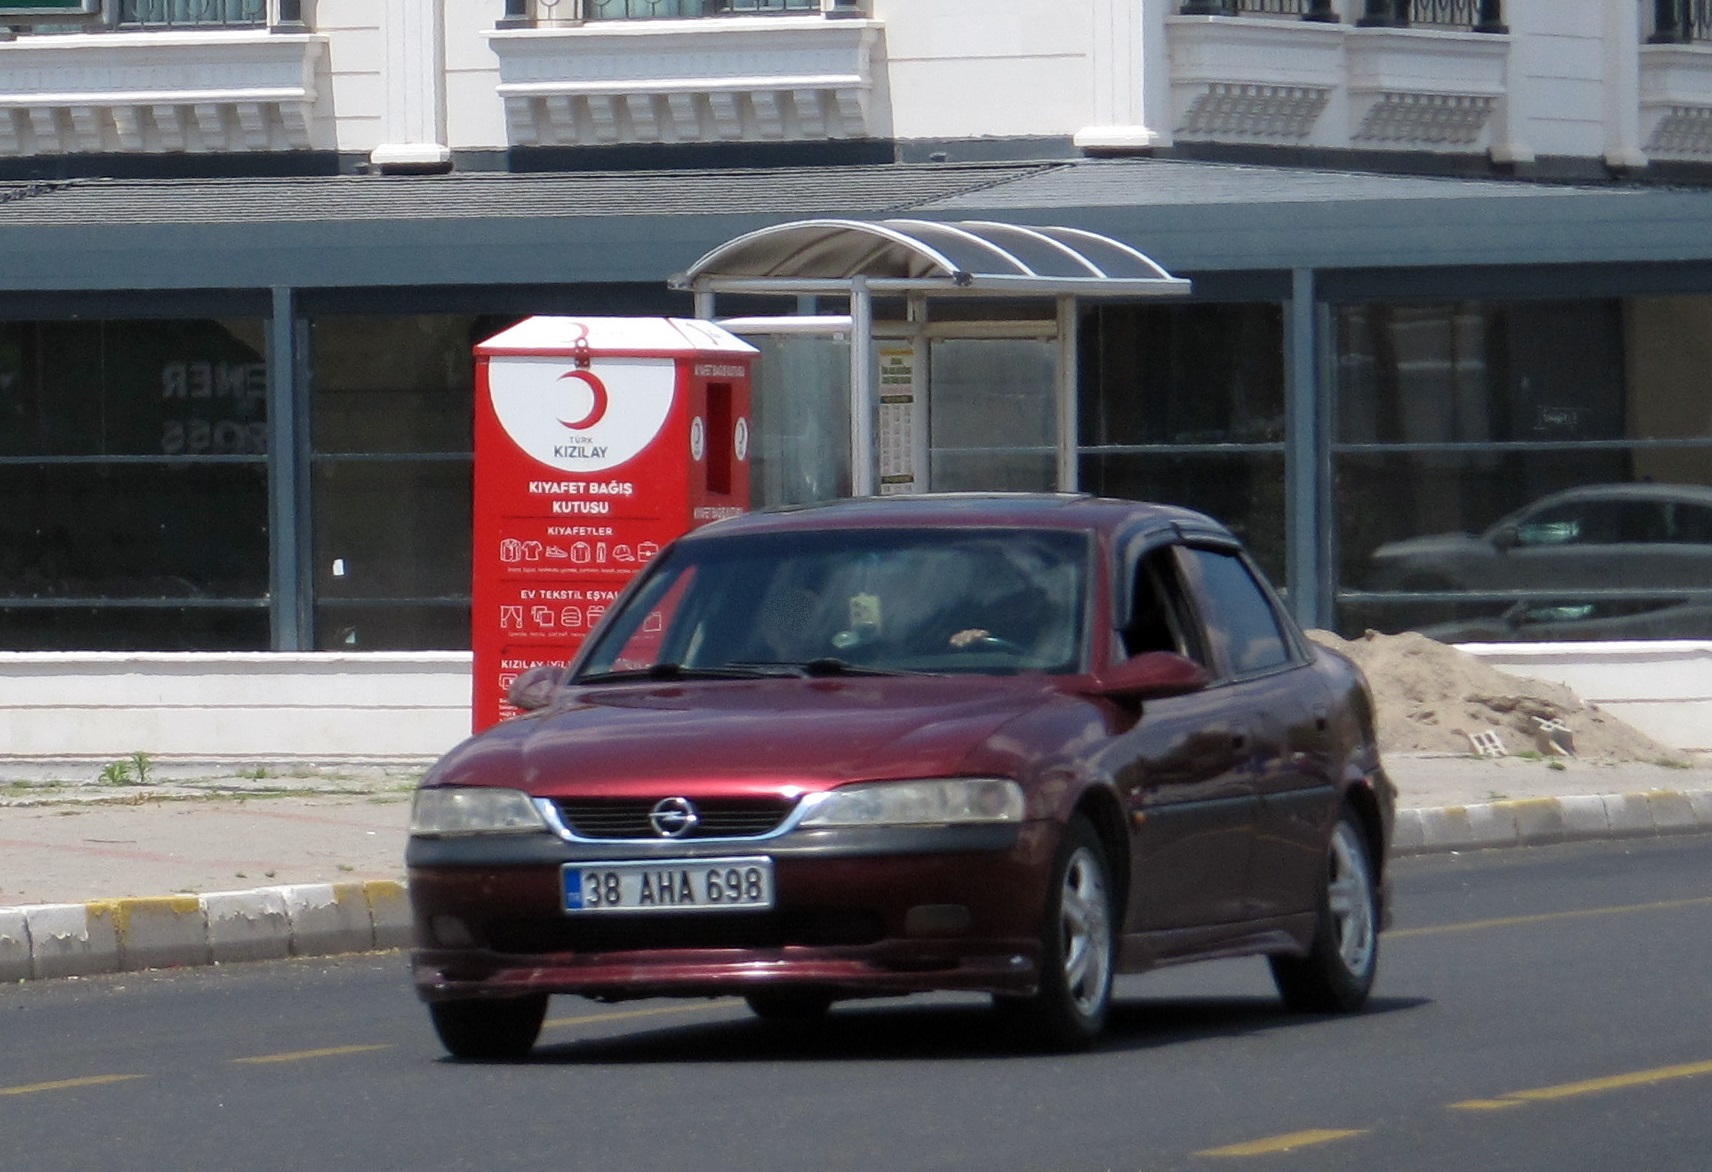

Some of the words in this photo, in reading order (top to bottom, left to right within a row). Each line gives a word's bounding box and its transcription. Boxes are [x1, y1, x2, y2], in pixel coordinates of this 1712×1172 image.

[553, 445, 608, 459] KIZILAY
[528, 481, 586, 494] KIYAFET
[589, 480, 633, 497] BAĞIŞ
[552, 500, 609, 514] KUTUSU
[547, 526, 613, 536] KIYAFETLER
[520, 589, 536, 599] EV
[539, 589, 583, 600] TEKSTİL
[585, 871, 620, 905] 38
[639, 868, 695, 905] AHA
[706, 866, 762, 903] 698
